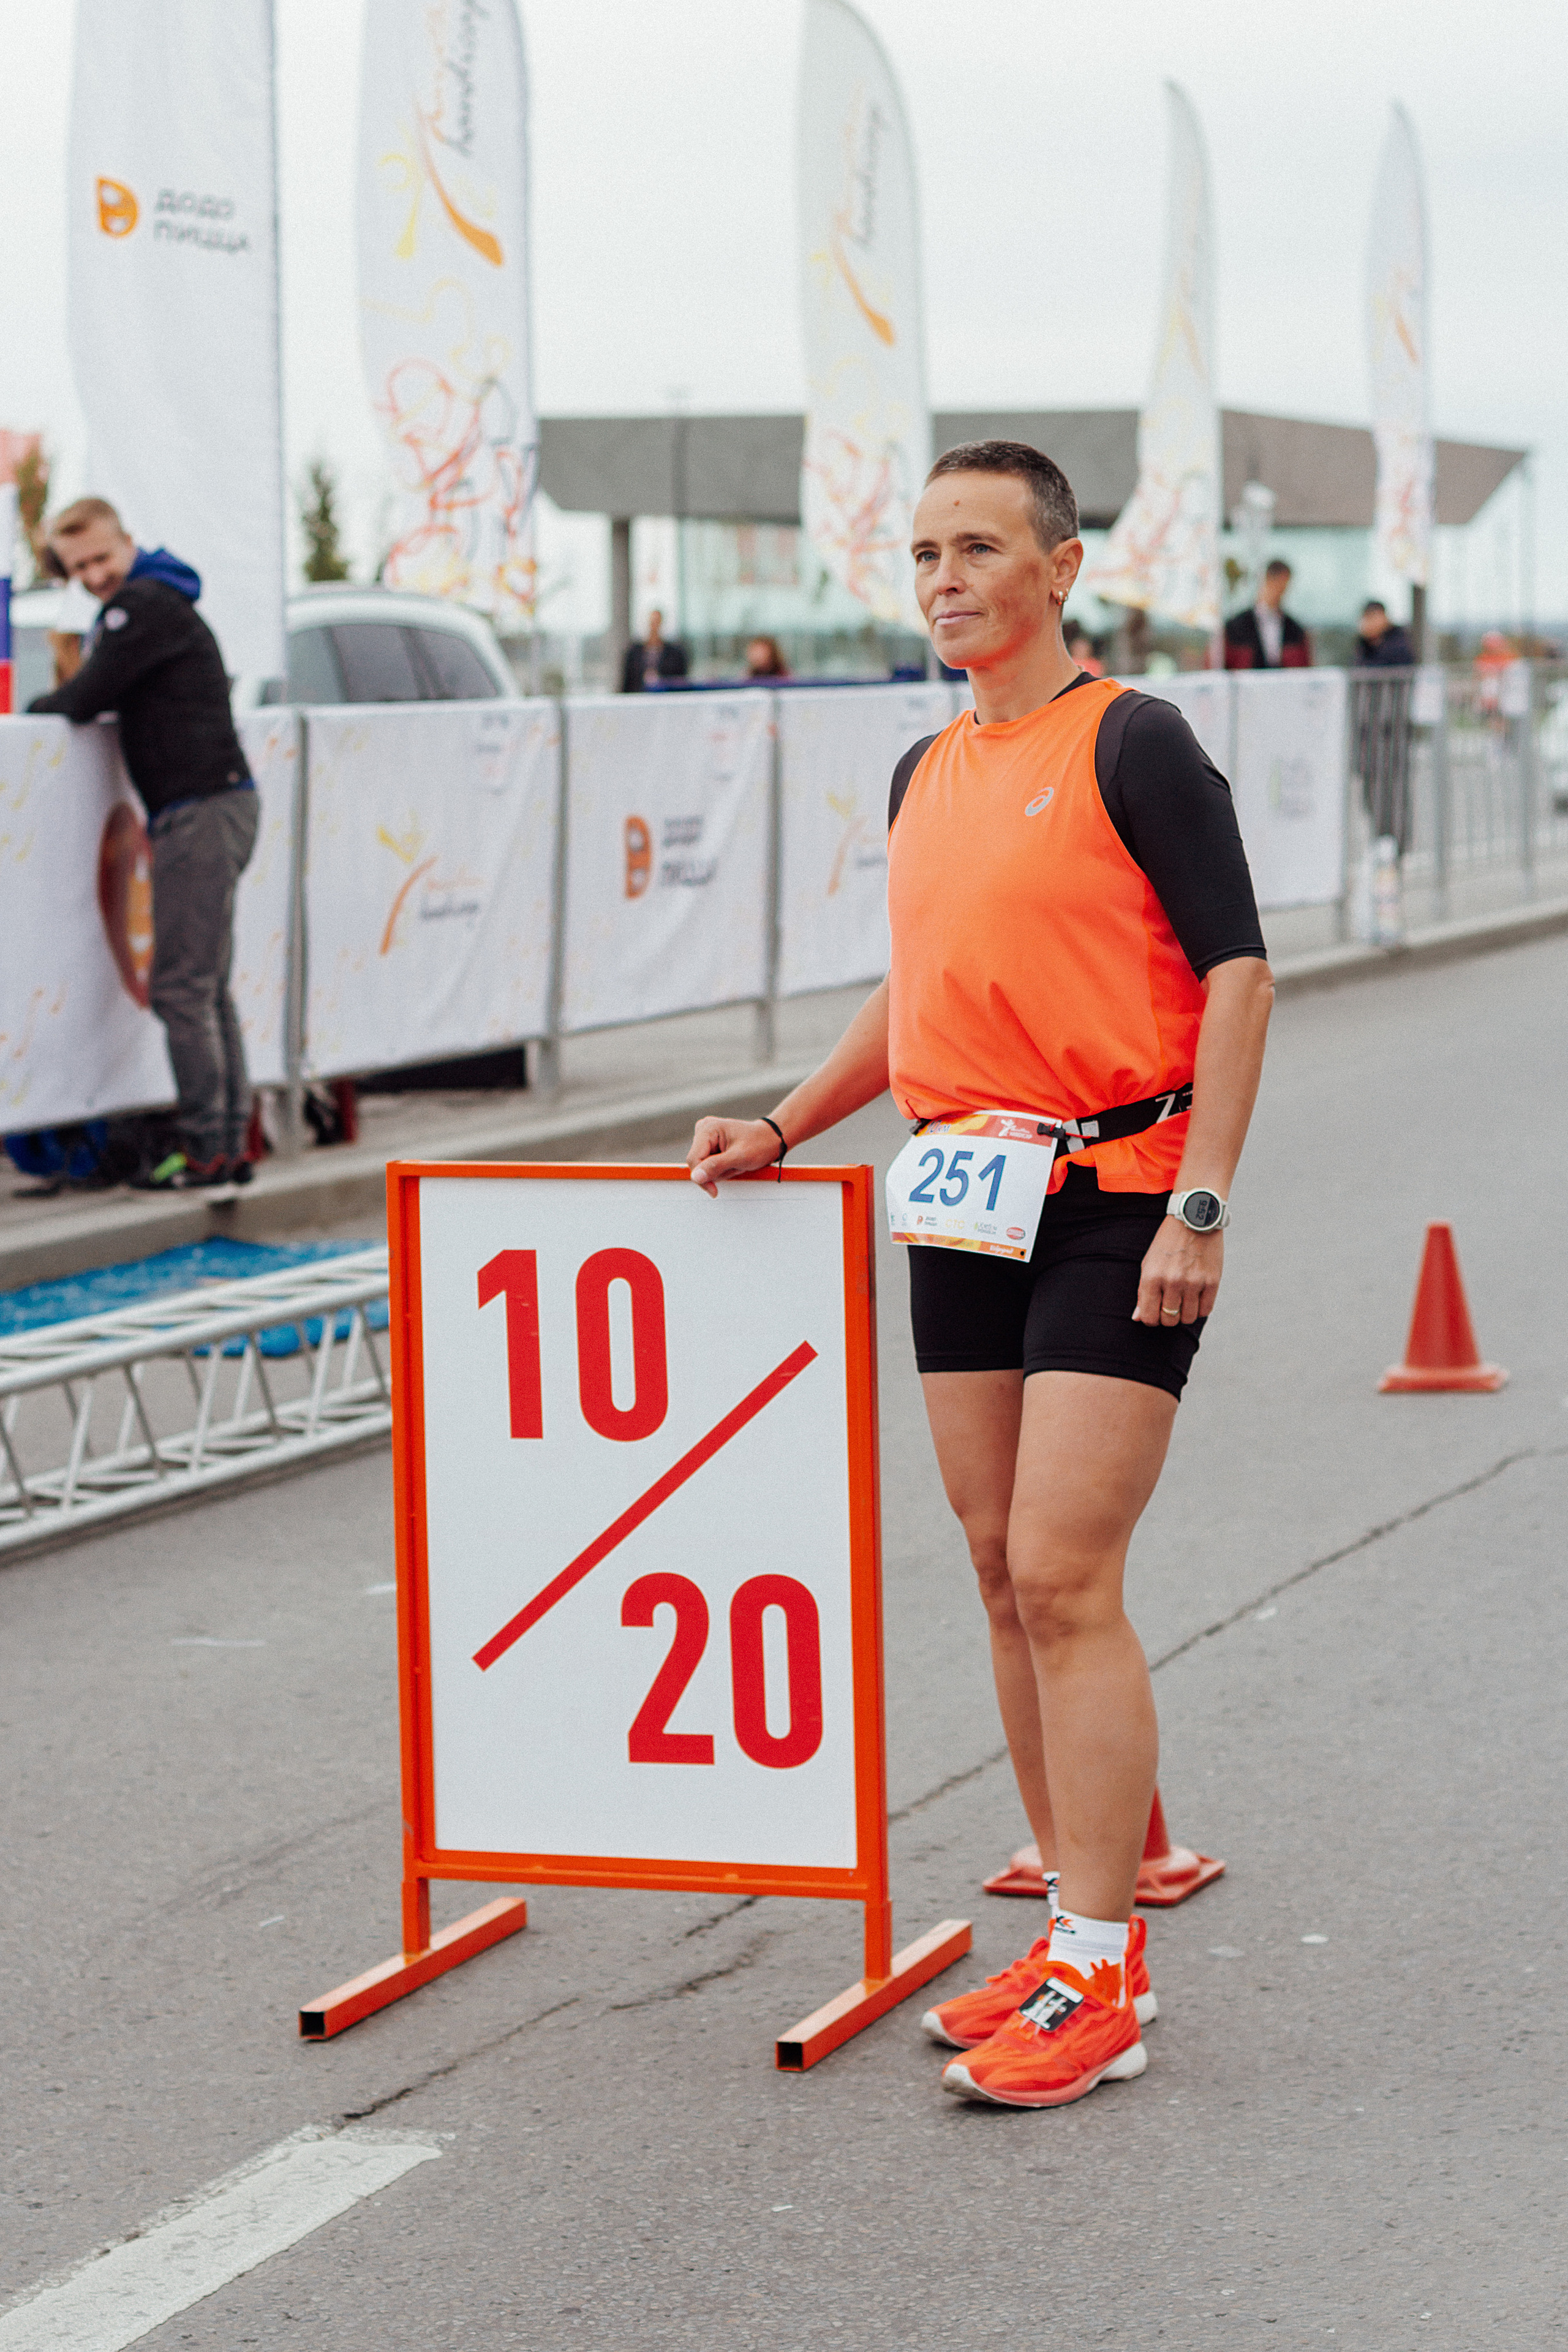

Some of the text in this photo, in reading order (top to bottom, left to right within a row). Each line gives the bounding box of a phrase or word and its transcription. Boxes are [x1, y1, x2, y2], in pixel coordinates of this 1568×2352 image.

[908, 1148, 1007, 1212] 251
[477, 1247, 668, 1442] 10
[620, 1572, 823, 1769] 20
